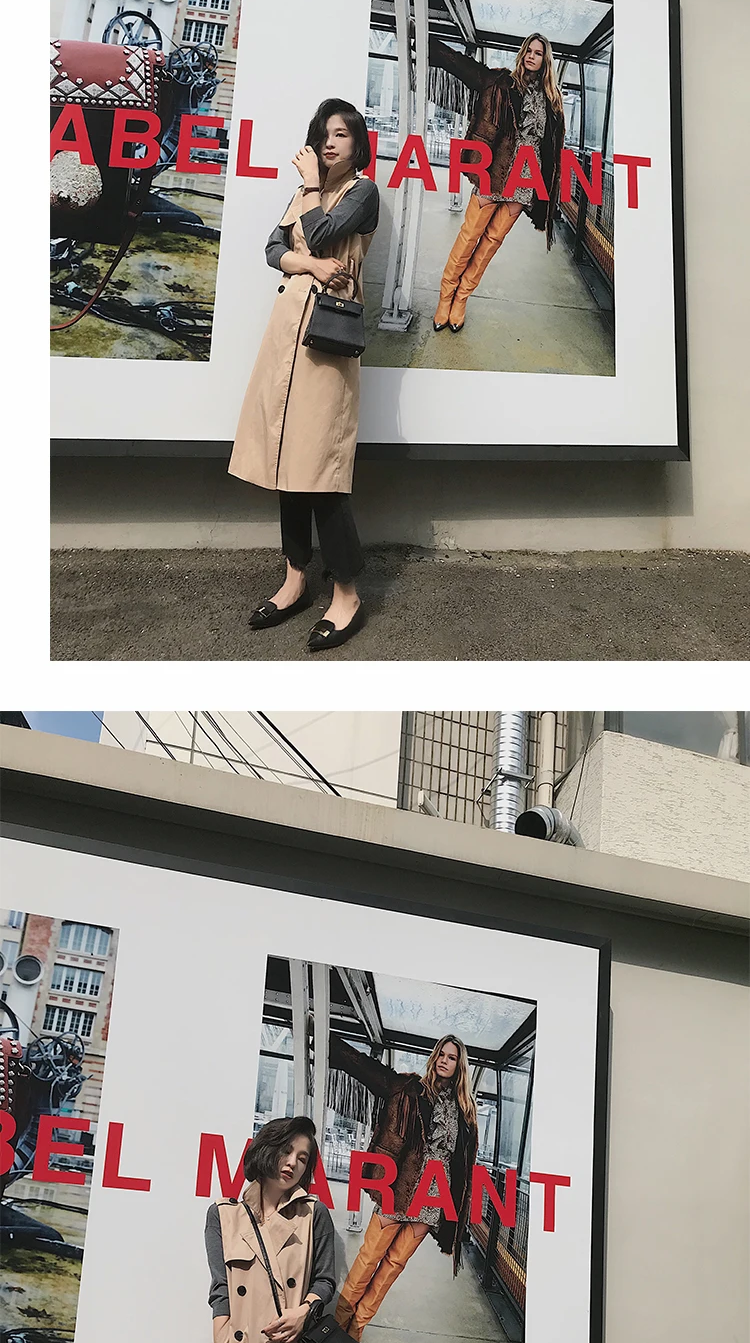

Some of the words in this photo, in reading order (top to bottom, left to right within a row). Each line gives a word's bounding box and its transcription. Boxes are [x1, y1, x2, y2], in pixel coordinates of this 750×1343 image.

[50, 103, 278, 179] ABEL
[363, 130, 651, 209] ARANT
[0, 1109, 151, 1192] EL
